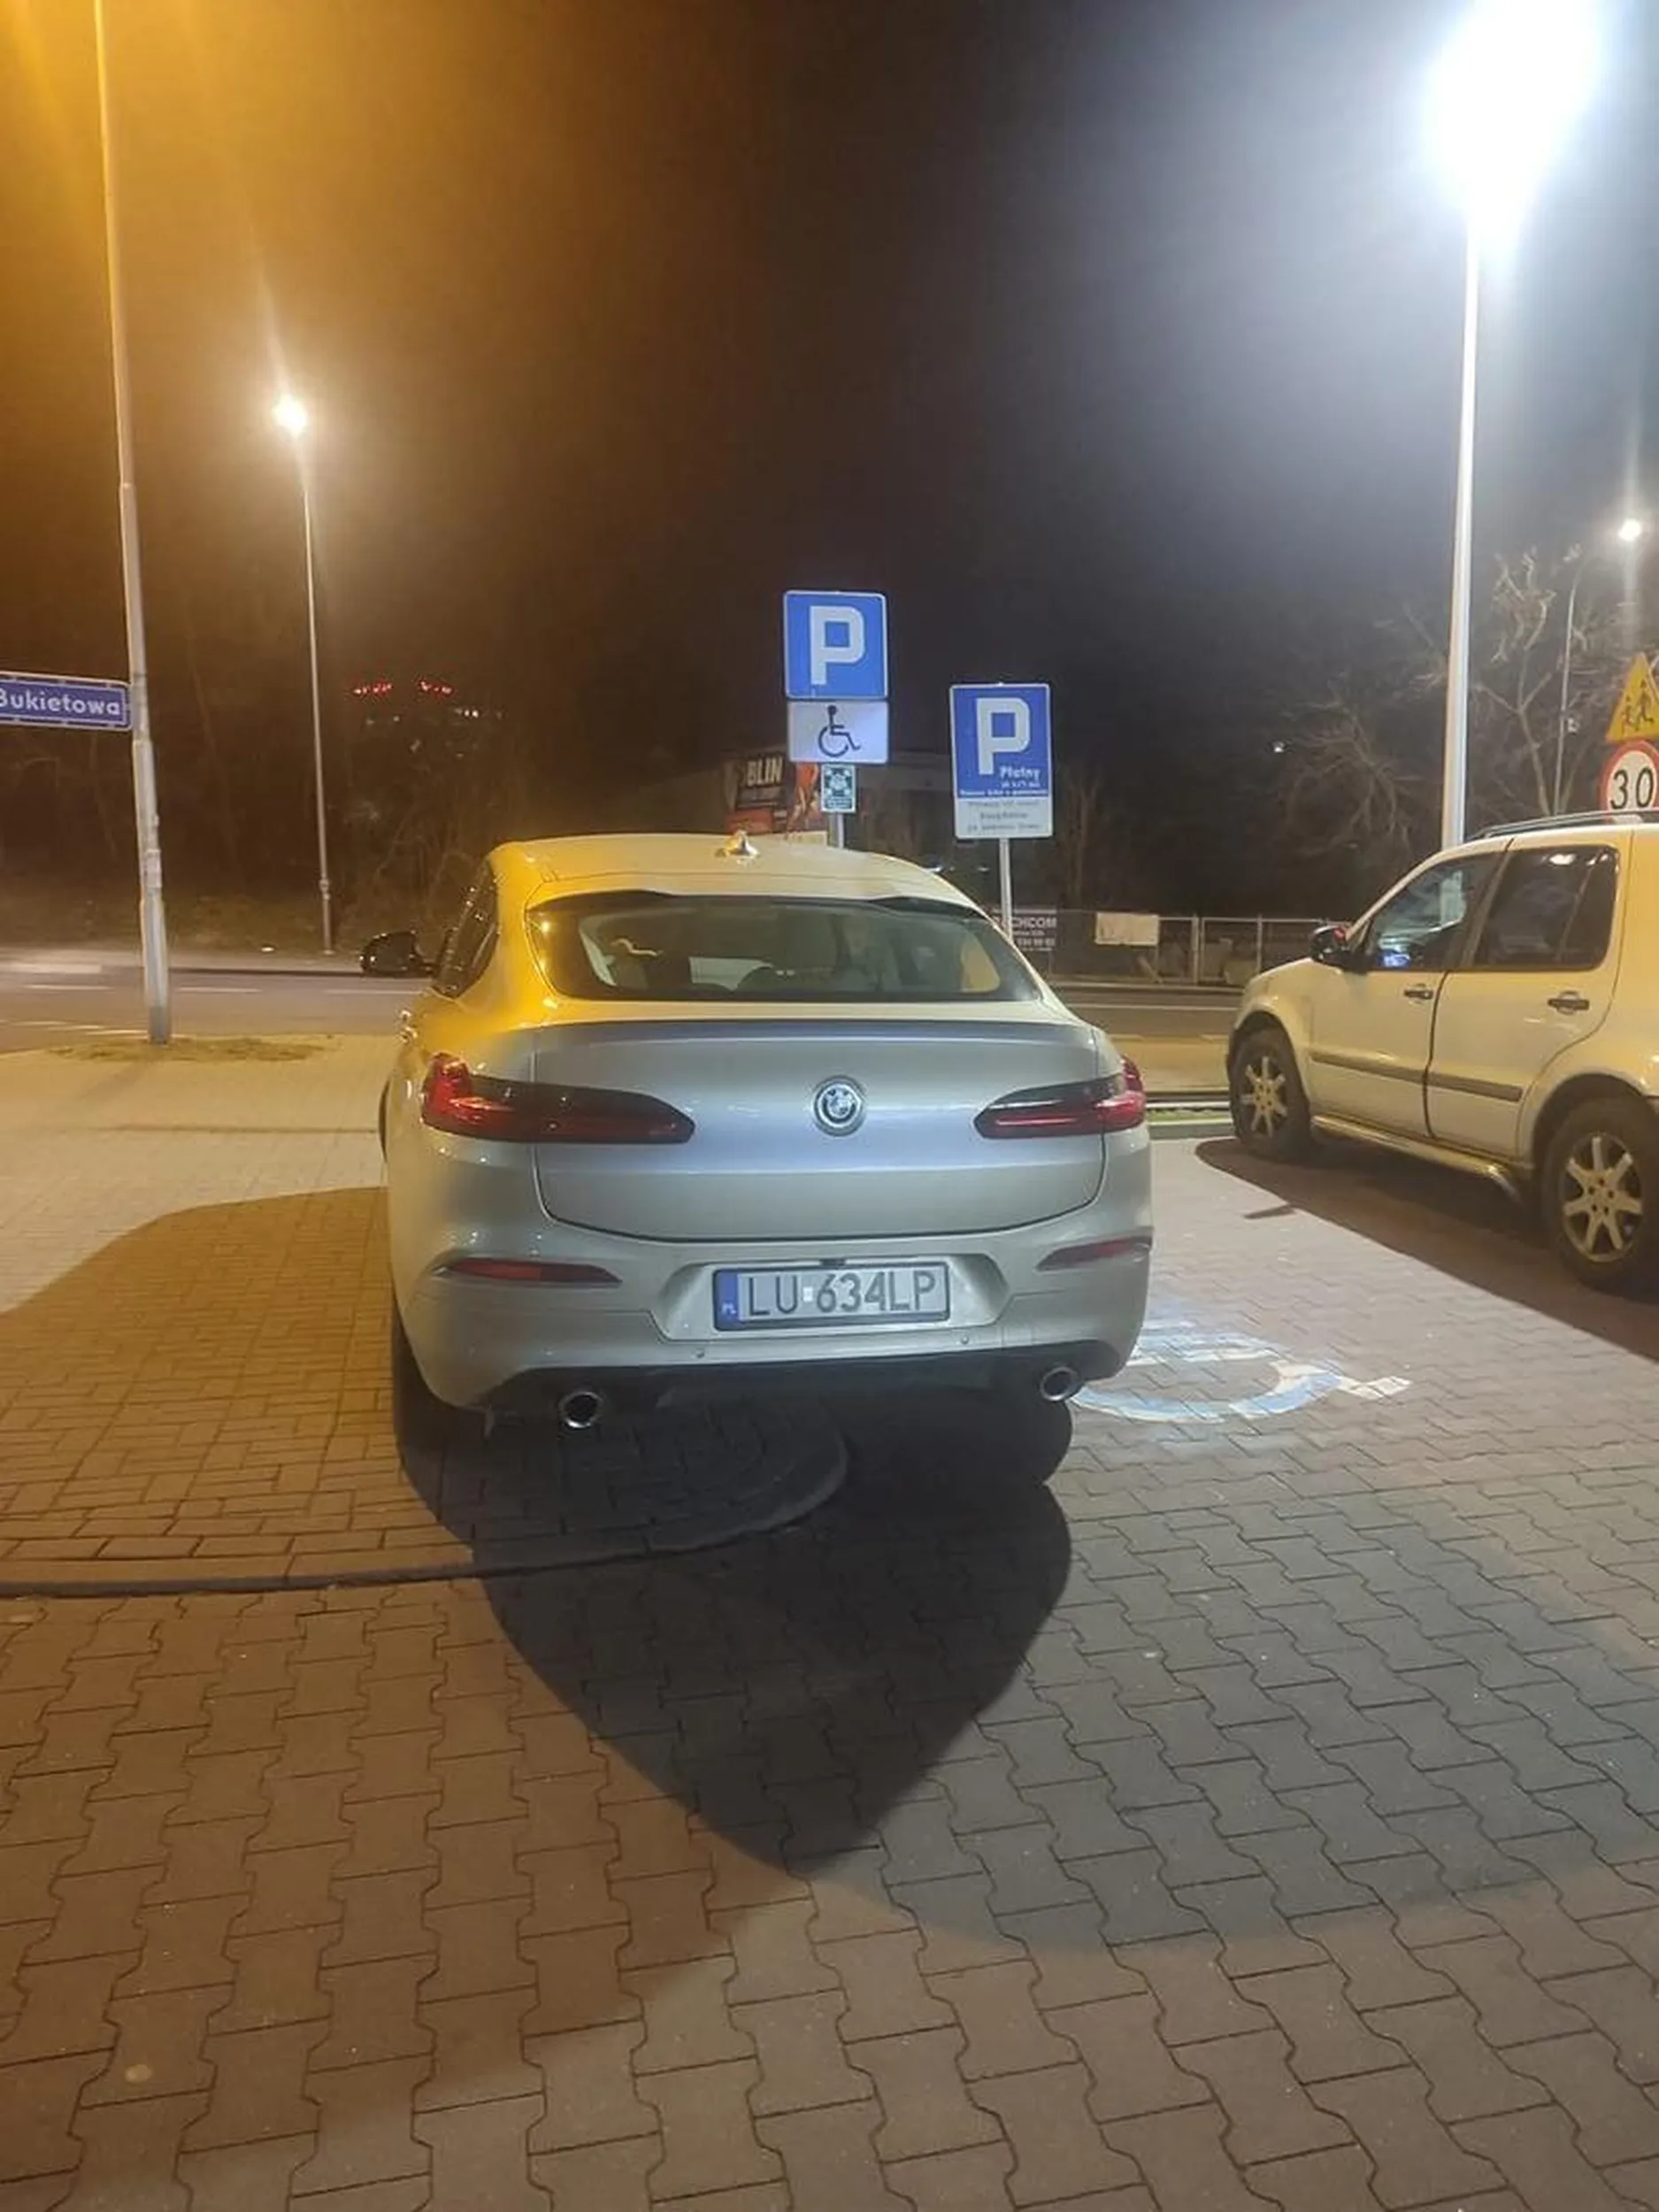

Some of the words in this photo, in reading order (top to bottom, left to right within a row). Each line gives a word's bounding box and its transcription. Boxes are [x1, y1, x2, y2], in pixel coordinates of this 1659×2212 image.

[810, 605, 865, 685] P
[0, 687, 120, 715] Bukietowa
[976, 697, 1031, 775] P
[1610, 767, 1654, 810] 30
[749, 1275, 797, 1316] LU
[816, 1271, 936, 1313] 634LP
